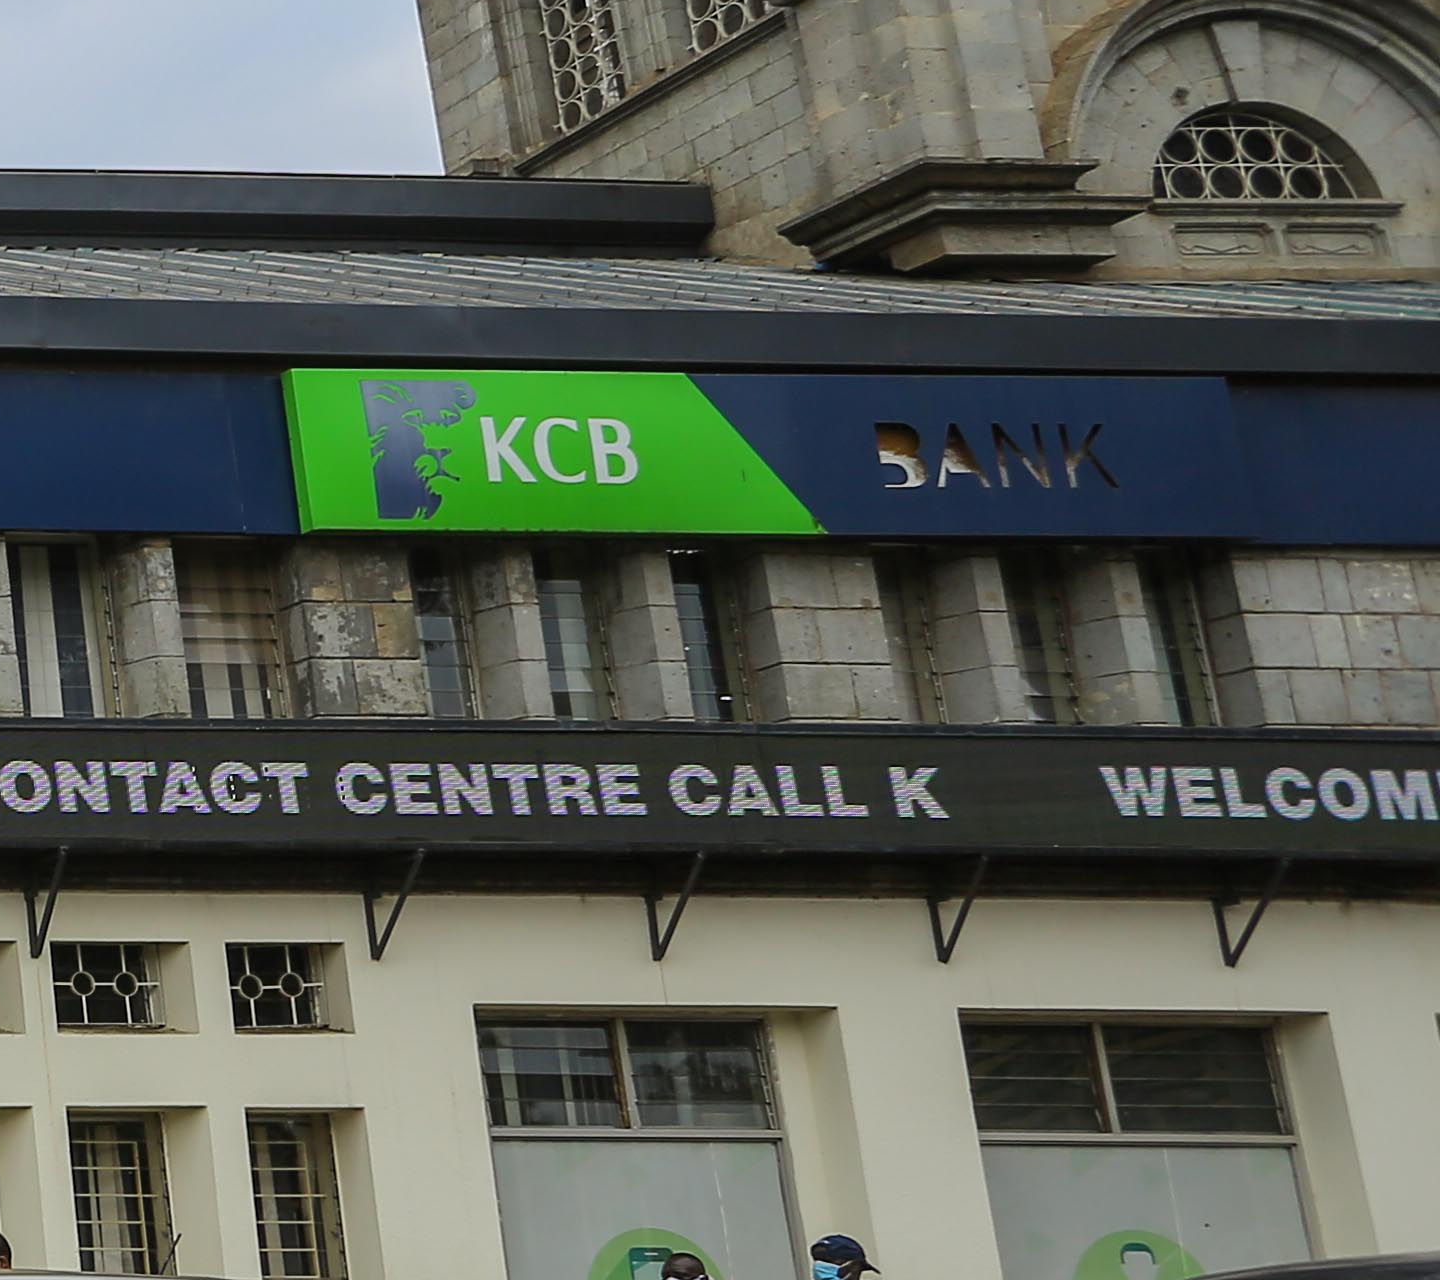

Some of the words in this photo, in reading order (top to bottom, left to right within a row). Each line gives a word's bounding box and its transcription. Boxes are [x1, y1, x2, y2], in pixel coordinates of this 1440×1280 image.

[480, 416, 640, 485] KCB
[873, 422, 1120, 489] BANK
[335, 762, 648, 816] CENTRE
[667, 764, 870, 817] CALL
[888, 766, 951, 819] K
[1098, 767, 1440, 821] WELCOM
